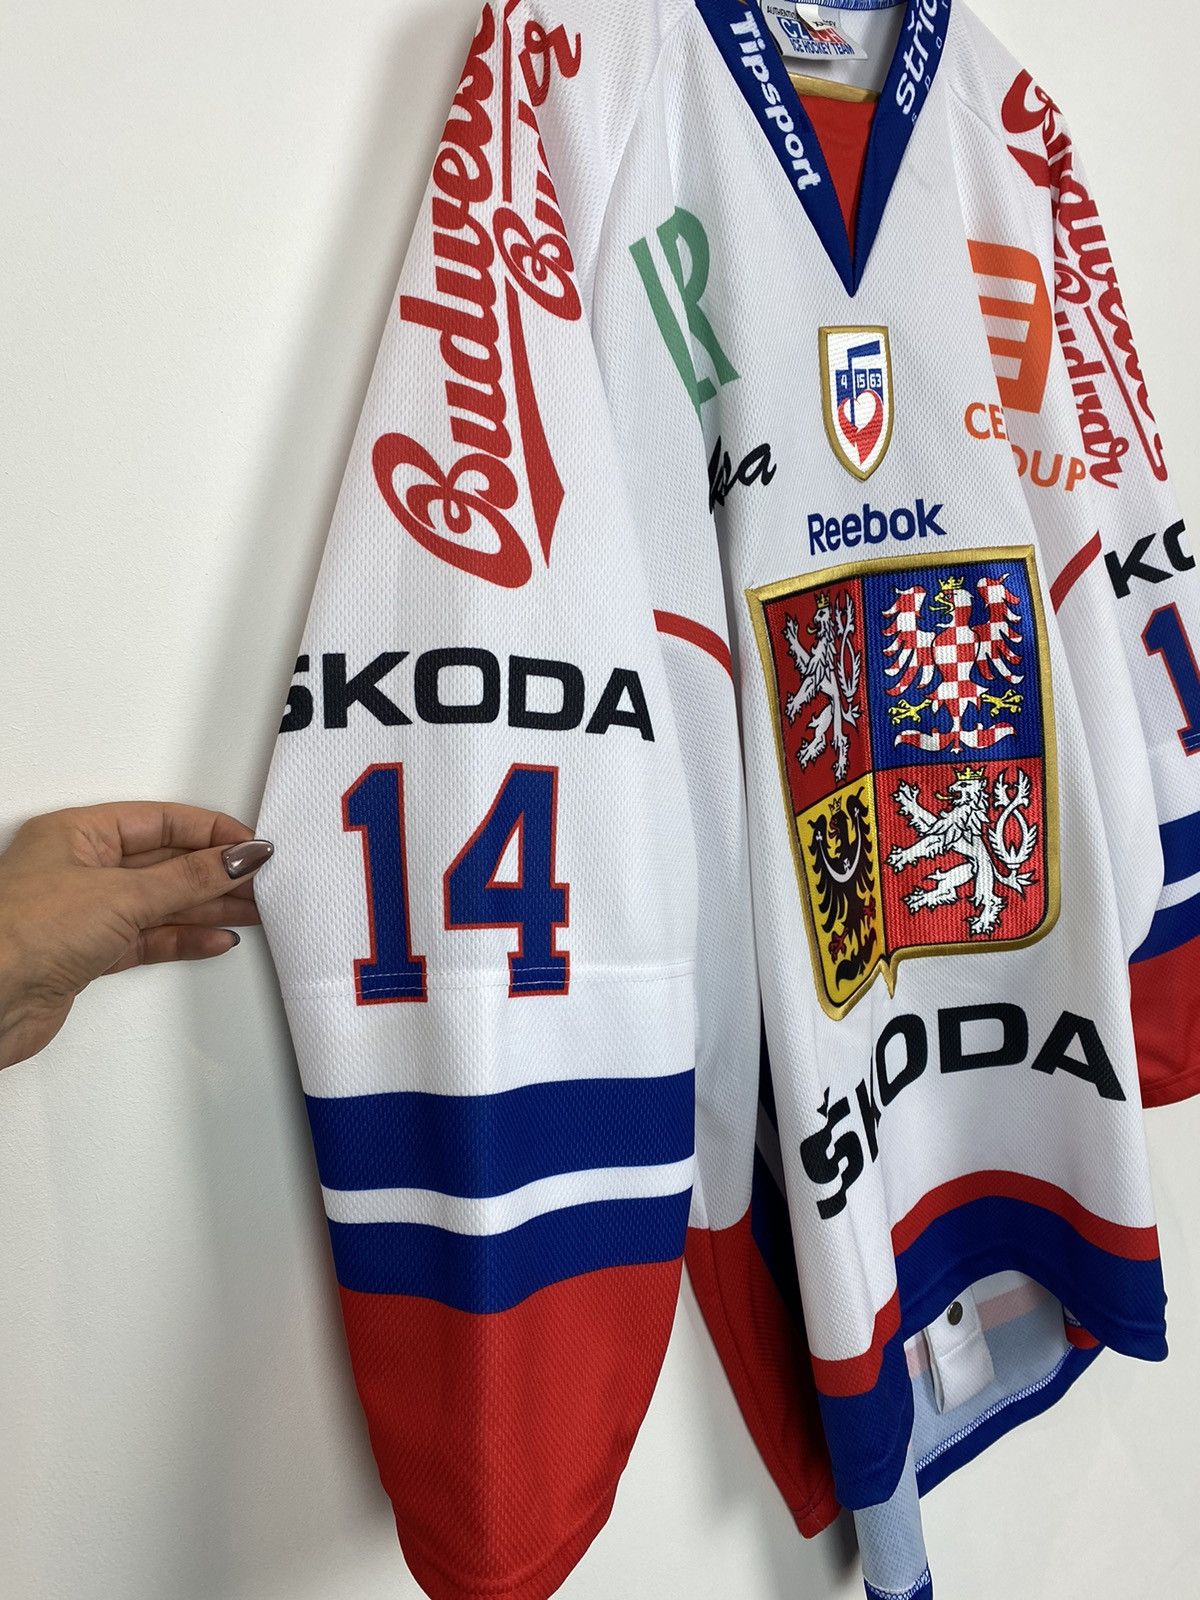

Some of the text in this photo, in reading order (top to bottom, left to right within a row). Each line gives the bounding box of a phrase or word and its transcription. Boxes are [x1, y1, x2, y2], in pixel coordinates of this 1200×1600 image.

[803, 40, 832, 55] HOCKEY
[831, 42, 855, 55] TEAM
[729, 10, 822, 191] Tipsport
[628, 205, 742, 421] LR
[839, 374, 882, 390] 4 15 63
[963, 401, 1010, 441] CE
[807, 498, 948, 556] Reebok
[341, 761, 571, 1007] 14
